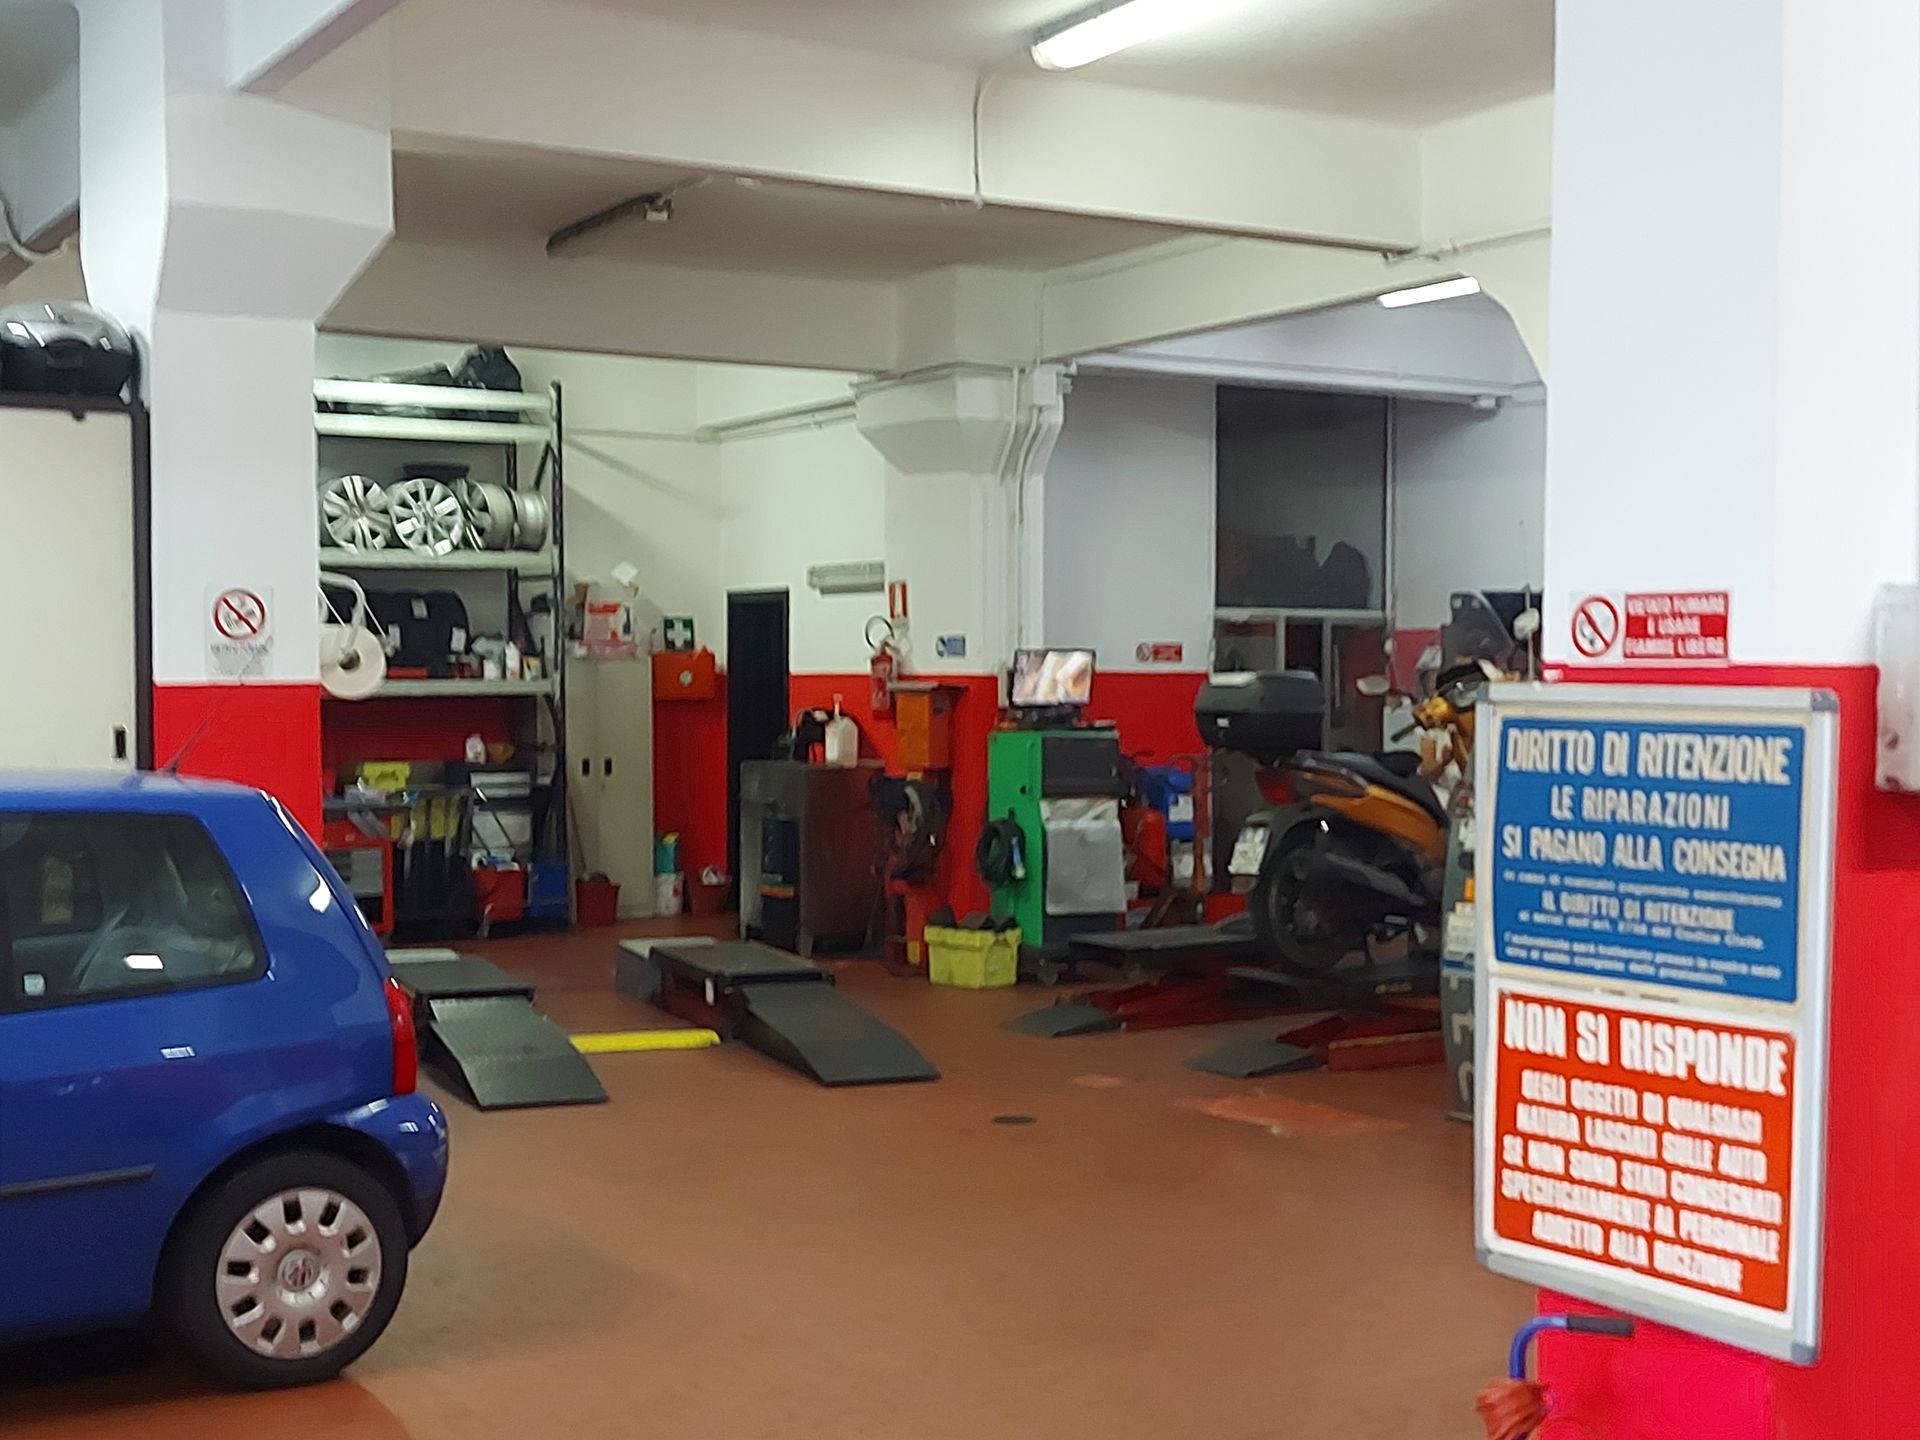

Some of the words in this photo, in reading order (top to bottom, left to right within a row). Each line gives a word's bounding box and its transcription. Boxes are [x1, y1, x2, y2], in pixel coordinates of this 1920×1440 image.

[1506, 727, 1596, 776] DIRITTO
[1602, 730, 1630, 777] DI
[1636, 731, 1793, 786] RITENZIONE
[1550, 785, 1575, 821] LE
[1582, 786, 1730, 830] RIPARAZIONI
[1502, 824, 1522, 859] SI
[1529, 826, 1606, 866] PAGANO
[1612, 833, 1664, 871] ALLA
[1673, 837, 1787, 882] CONSEGNA
[1504, 998, 1567, 1060] NON
[1576, 1010, 1610, 1065] SI
[1619, 1017, 1787, 1096] RISPONDE
[1570, 1078, 1638, 1120] OGGETTI
[1642, 1091, 1664, 1125] DI
[1667, 1095, 1762, 1144] QUALSIASI
[1661, 1131, 1713, 1172] SULLE
[1679, 1209, 1780, 1264] PERSONALE
